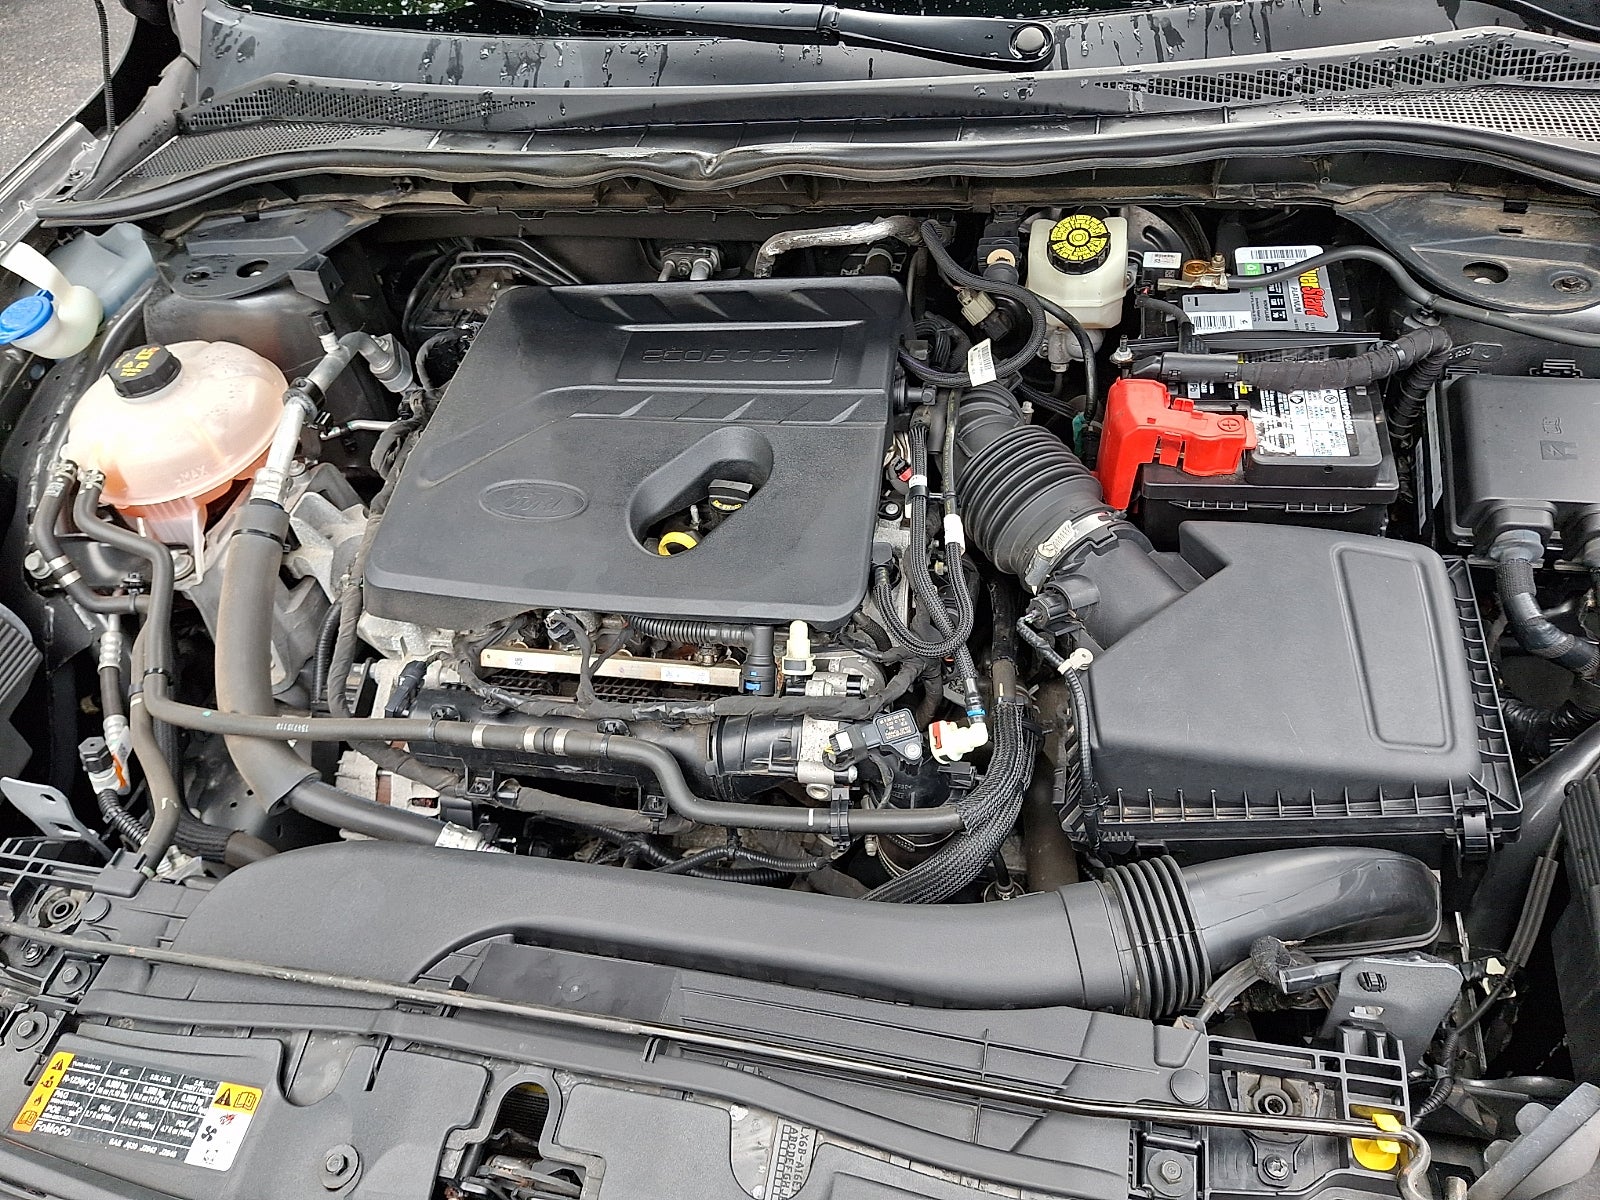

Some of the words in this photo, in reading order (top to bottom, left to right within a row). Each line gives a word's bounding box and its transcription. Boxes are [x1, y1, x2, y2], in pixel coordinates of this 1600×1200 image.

[1291, 286, 1302, 313] PLATINUM
[1299, 268, 1328, 319] verStart
[642, 349, 818, 363] ECOBOOST
[503, 491, 564, 513] Ford
[33, 1121, 72, 1136] FoMoCo
